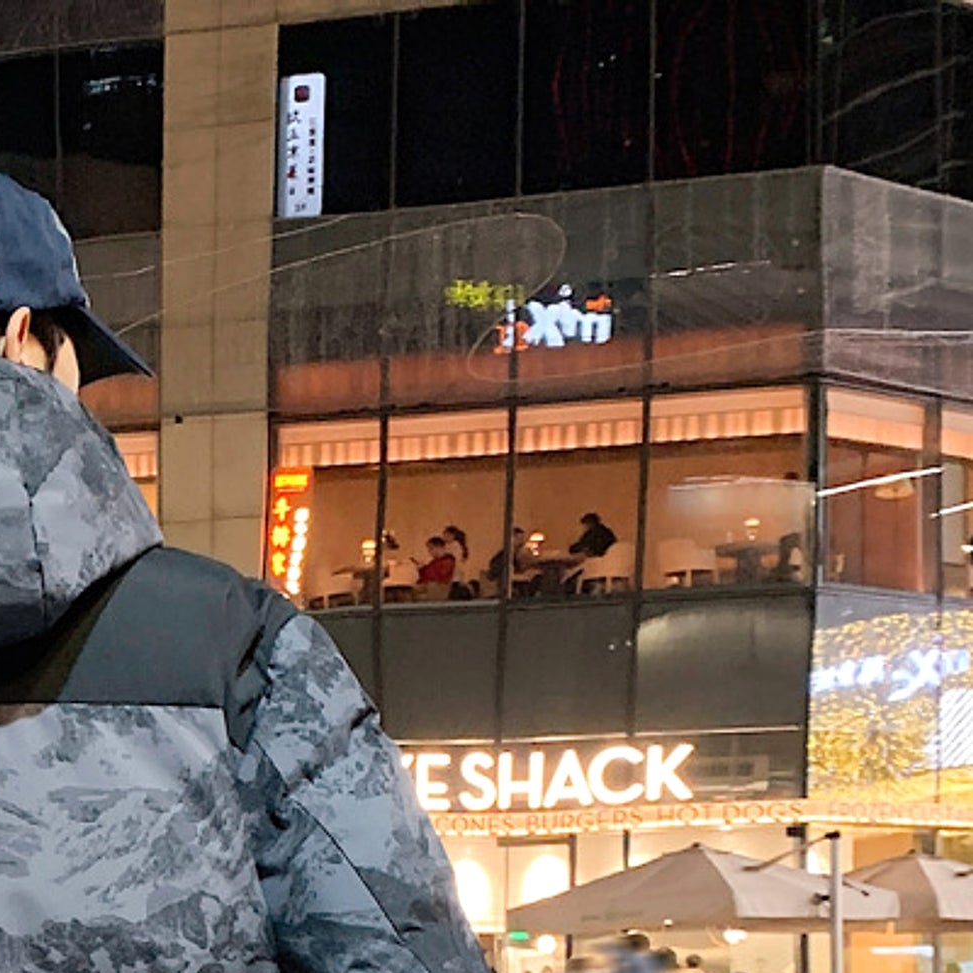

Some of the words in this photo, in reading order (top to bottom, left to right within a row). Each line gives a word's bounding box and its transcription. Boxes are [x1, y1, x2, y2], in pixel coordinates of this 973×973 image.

[401, 753, 451, 811] E
[458, 743, 694, 810] SHACK
[527, 804, 644, 832] BURGERS
[657, 803, 711, 824] HOT
[722, 801, 803, 824] DOGS
